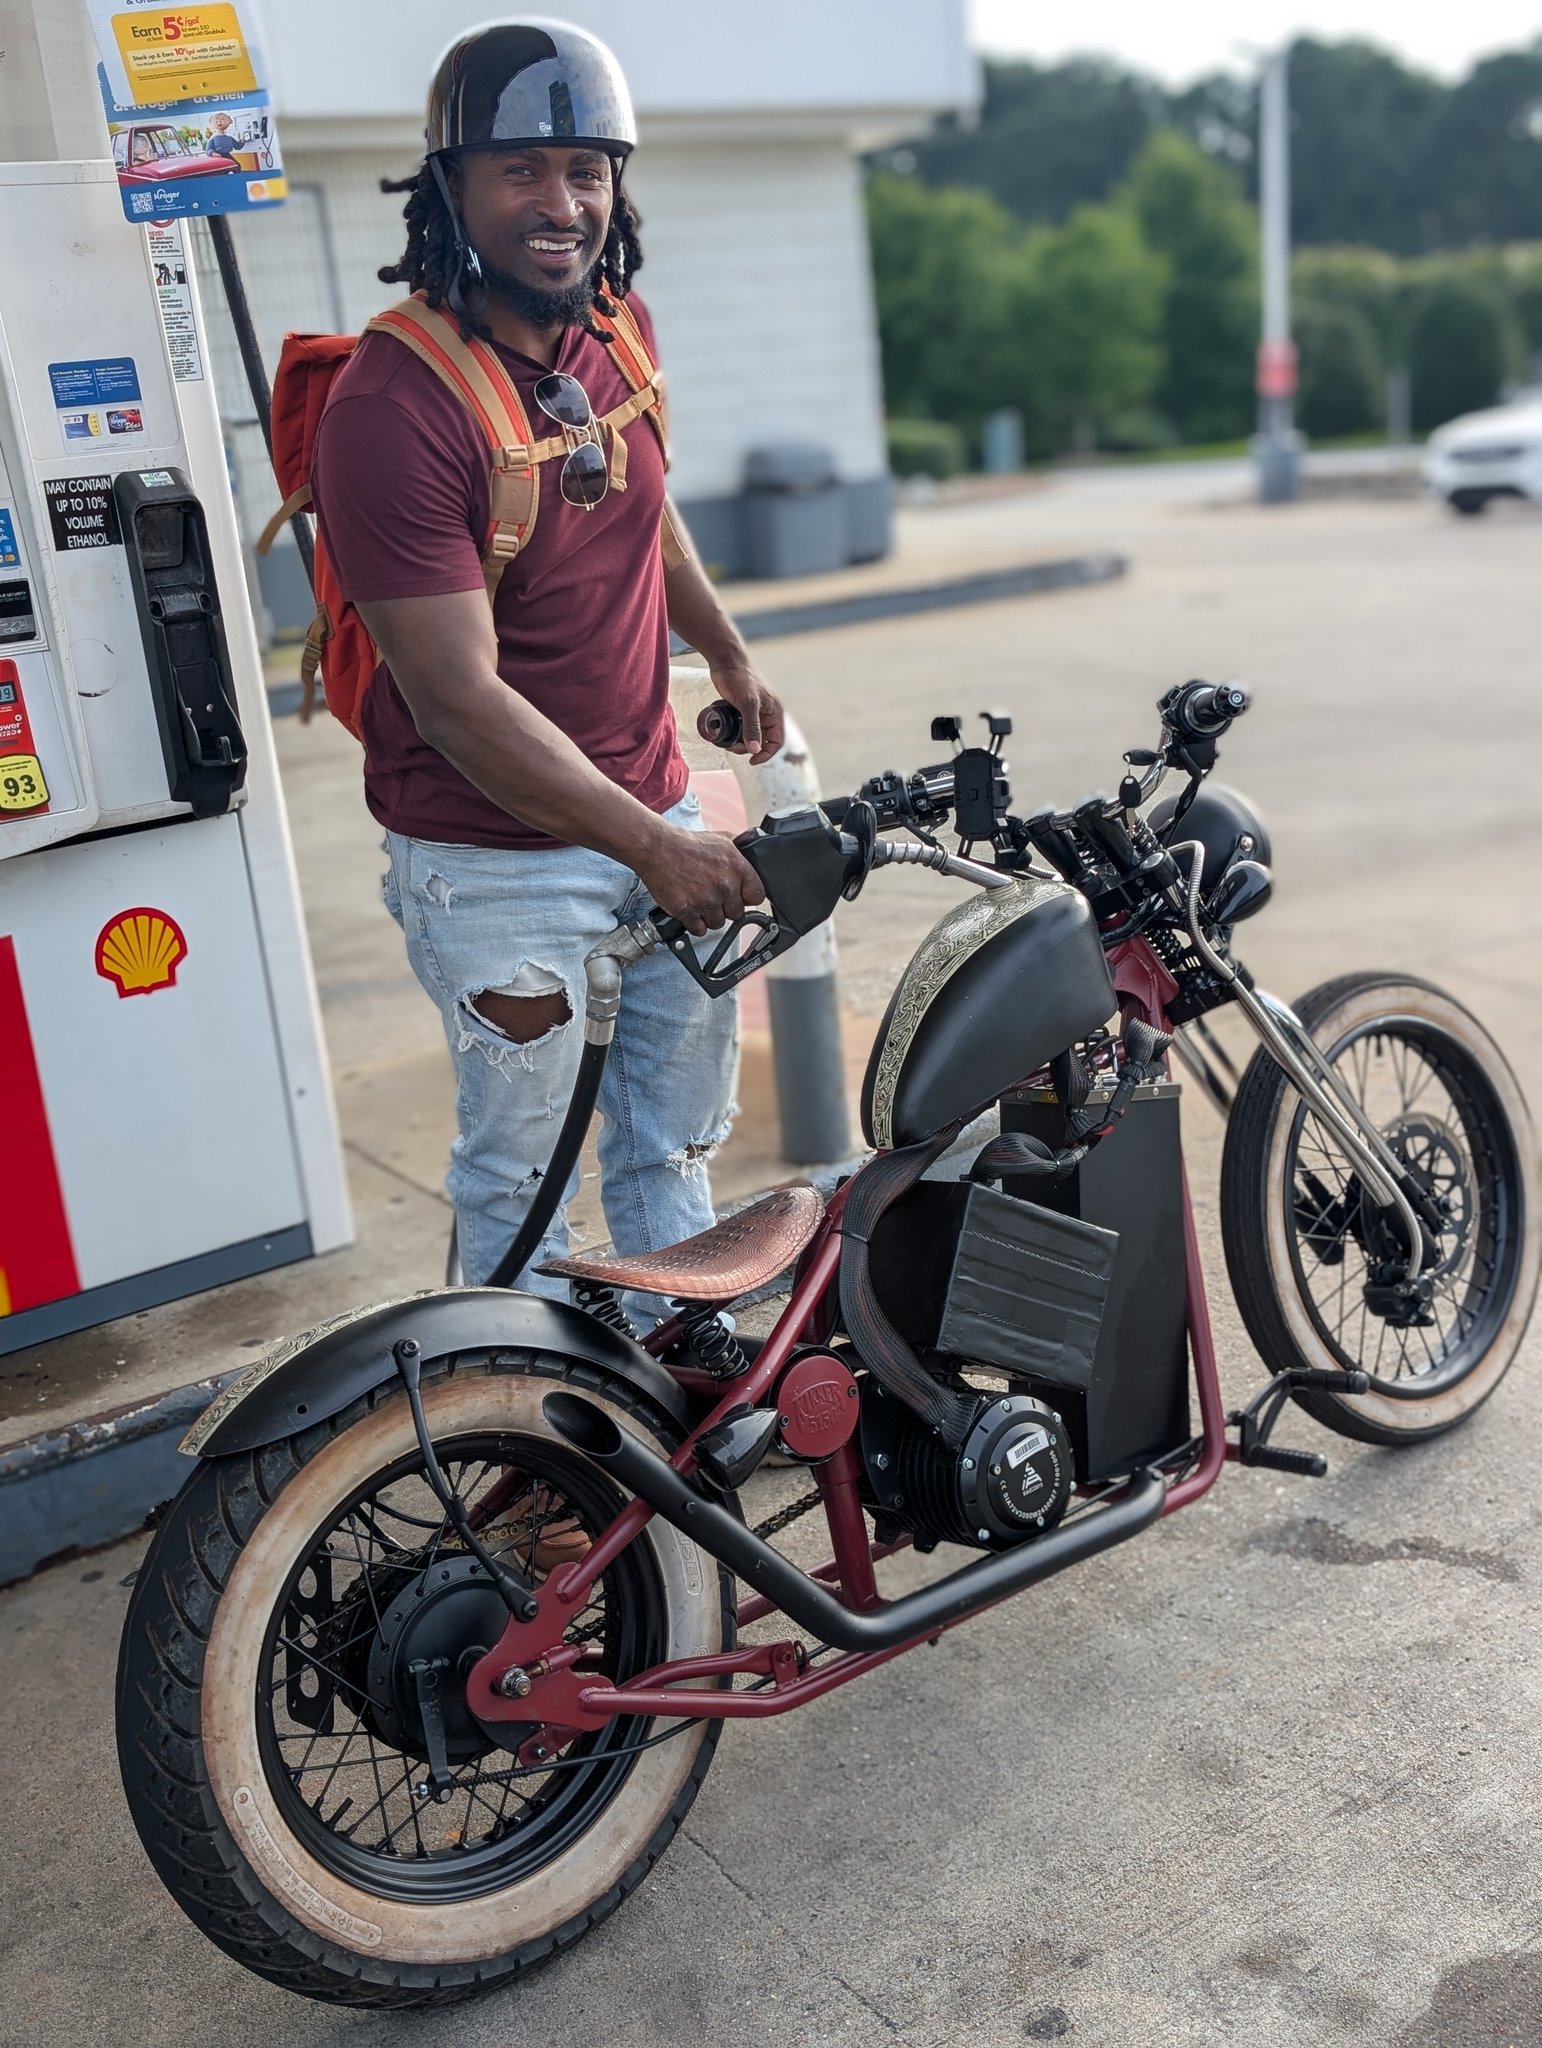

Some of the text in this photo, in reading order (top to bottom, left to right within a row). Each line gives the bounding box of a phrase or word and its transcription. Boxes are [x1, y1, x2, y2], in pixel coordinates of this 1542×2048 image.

[131, 26, 162, 38] Earn
[154, 188, 181, 204] Kroger
[46, 478, 111, 495] MAY CONTAIN
[56, 496, 107, 512] UP TO 10%
[65, 515, 104, 530] VOLUME
[67, 533, 110, 548] ETHANOL
[3, 774, 37, 797] 93
